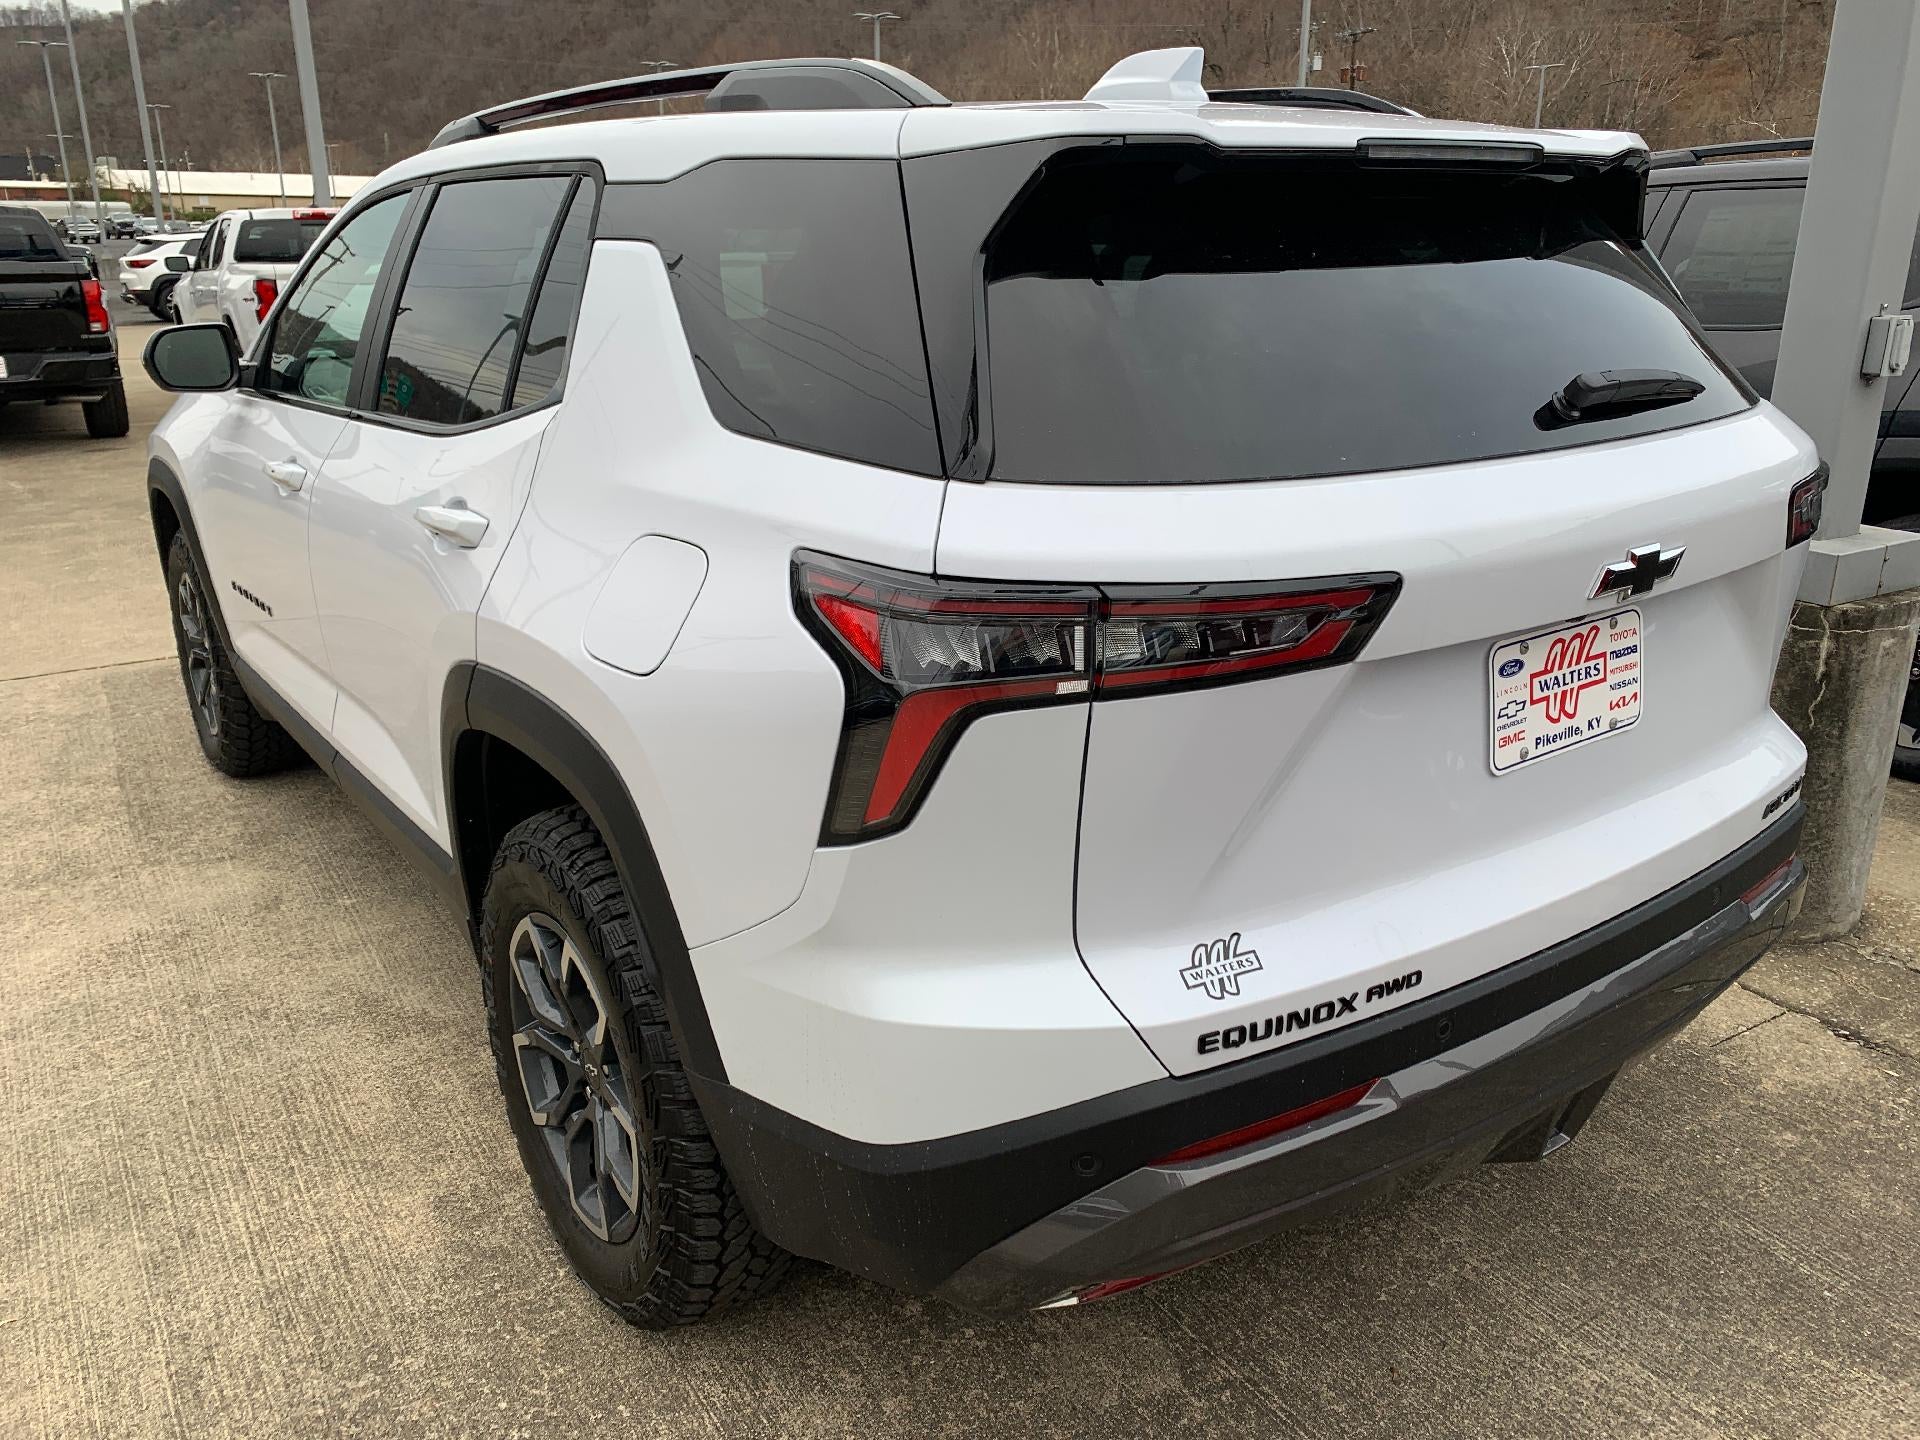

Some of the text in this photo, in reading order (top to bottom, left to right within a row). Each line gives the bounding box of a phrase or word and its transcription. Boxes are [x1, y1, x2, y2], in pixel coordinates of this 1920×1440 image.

[1609, 627, 1638, 642] TOYOTA
[1538, 663, 1601, 692] WALTERS
[1609, 677, 1639, 691] NISSAN
[1609, 692, 1638, 711] KIA
[1496, 717, 1528, 732] CHEVROLET
[1535, 725, 1583, 750] Pikeville,
[1587, 716, 1602, 731] KY
[1498, 730, 1526, 748] GMC
[1189, 956, 1255, 982] WALTERS
[1197, 969, 1422, 1054] EQUINOX AWD
